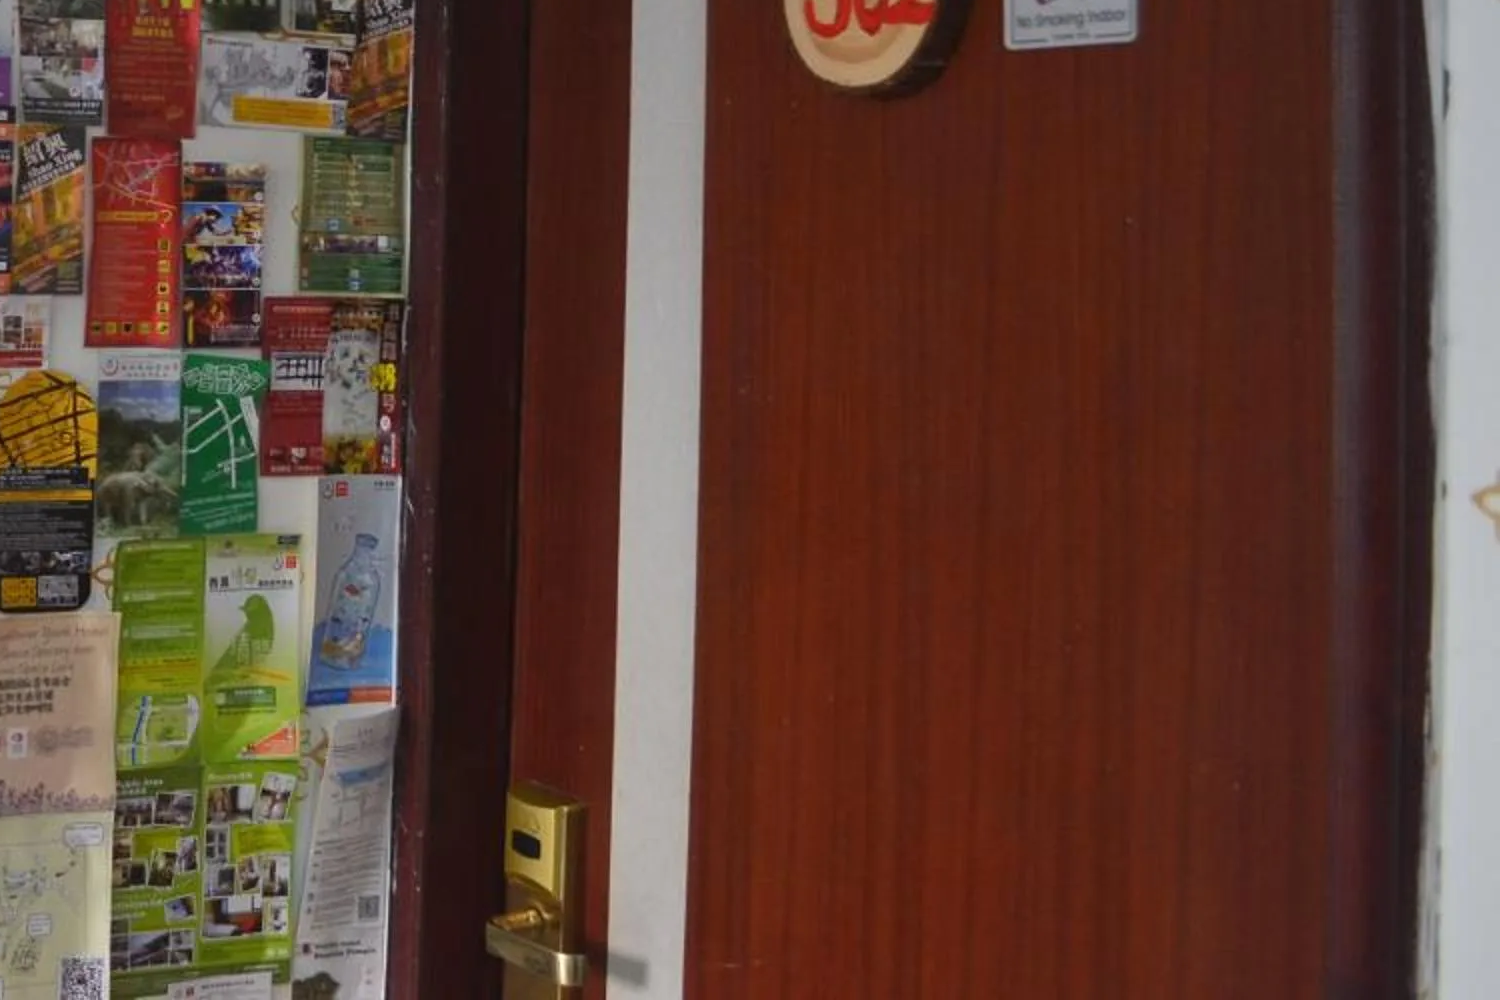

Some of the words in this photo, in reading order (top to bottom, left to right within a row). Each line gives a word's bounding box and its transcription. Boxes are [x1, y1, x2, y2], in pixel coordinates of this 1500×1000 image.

[1017, 15, 1032, 29] No
[1034, 12, 1085, 29] Smoking
[1087, 9, 1126, 22] Indoor
